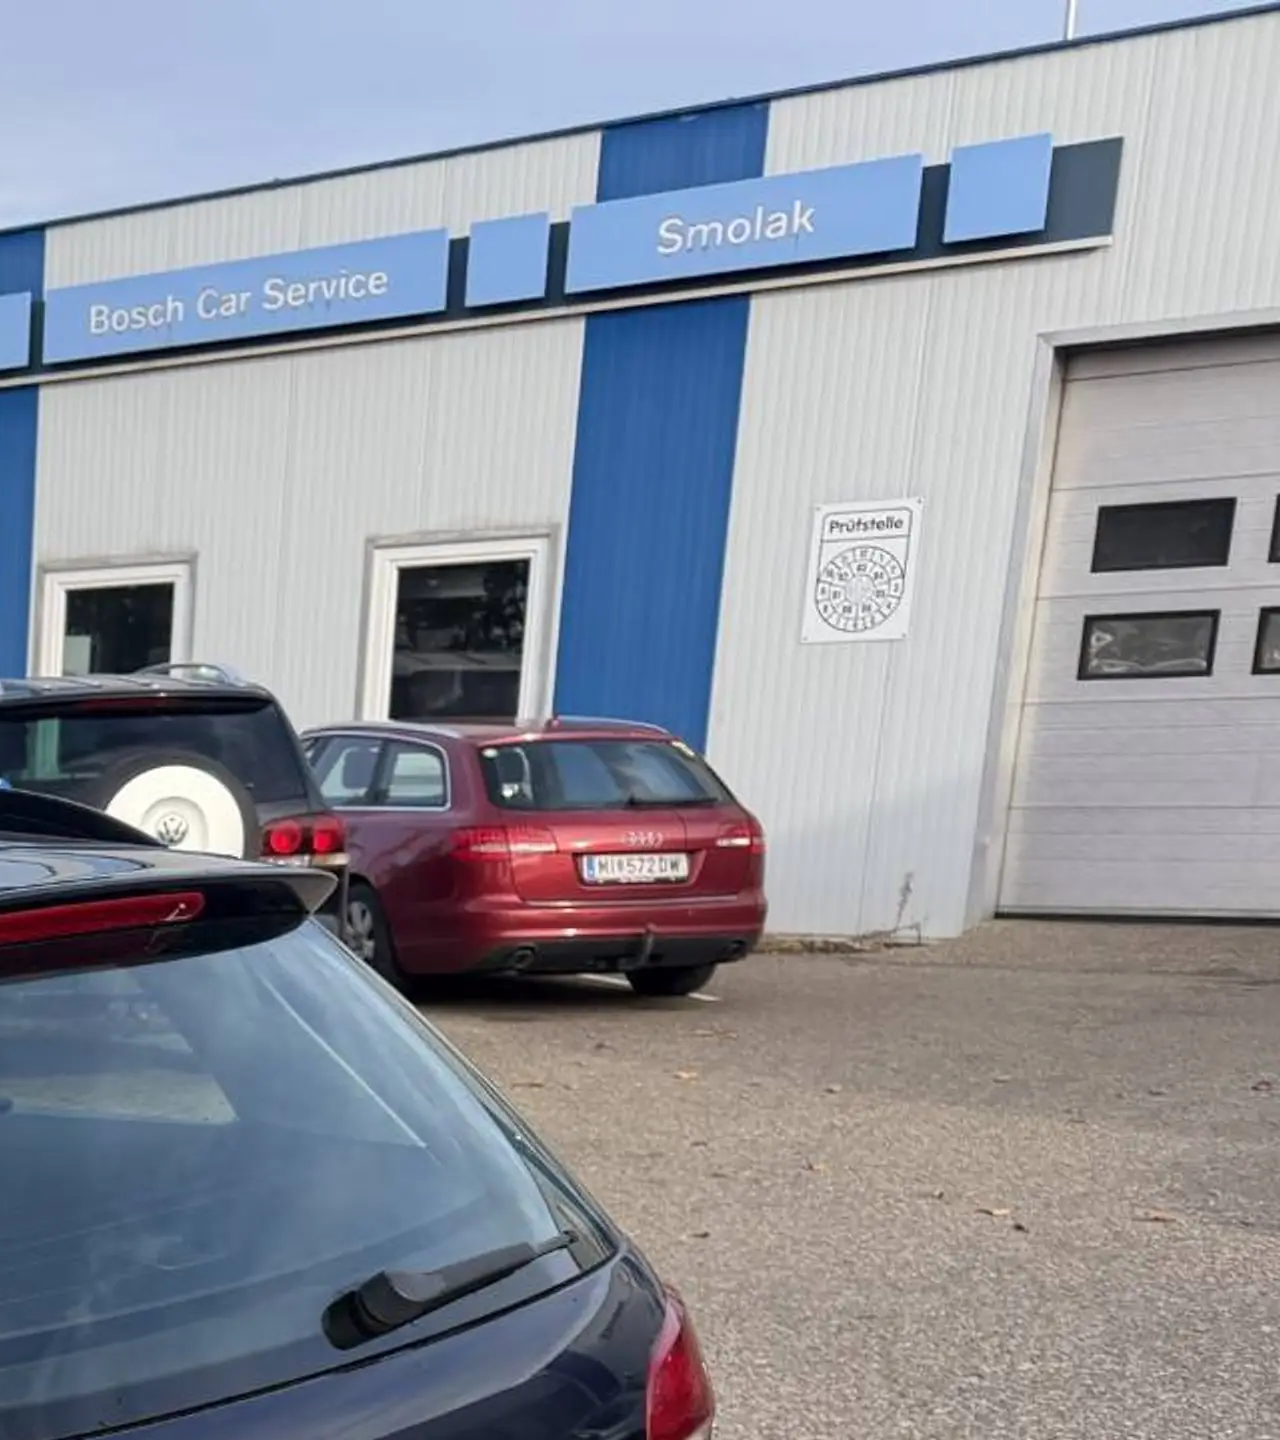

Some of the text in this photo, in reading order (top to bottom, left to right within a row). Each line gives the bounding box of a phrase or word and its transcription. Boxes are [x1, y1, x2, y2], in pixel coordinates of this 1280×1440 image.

[656, 200, 815, 255] Smolak
[89, 269, 389, 334] Bosch Car Service
[829, 516, 904, 534] Prüfstelle
